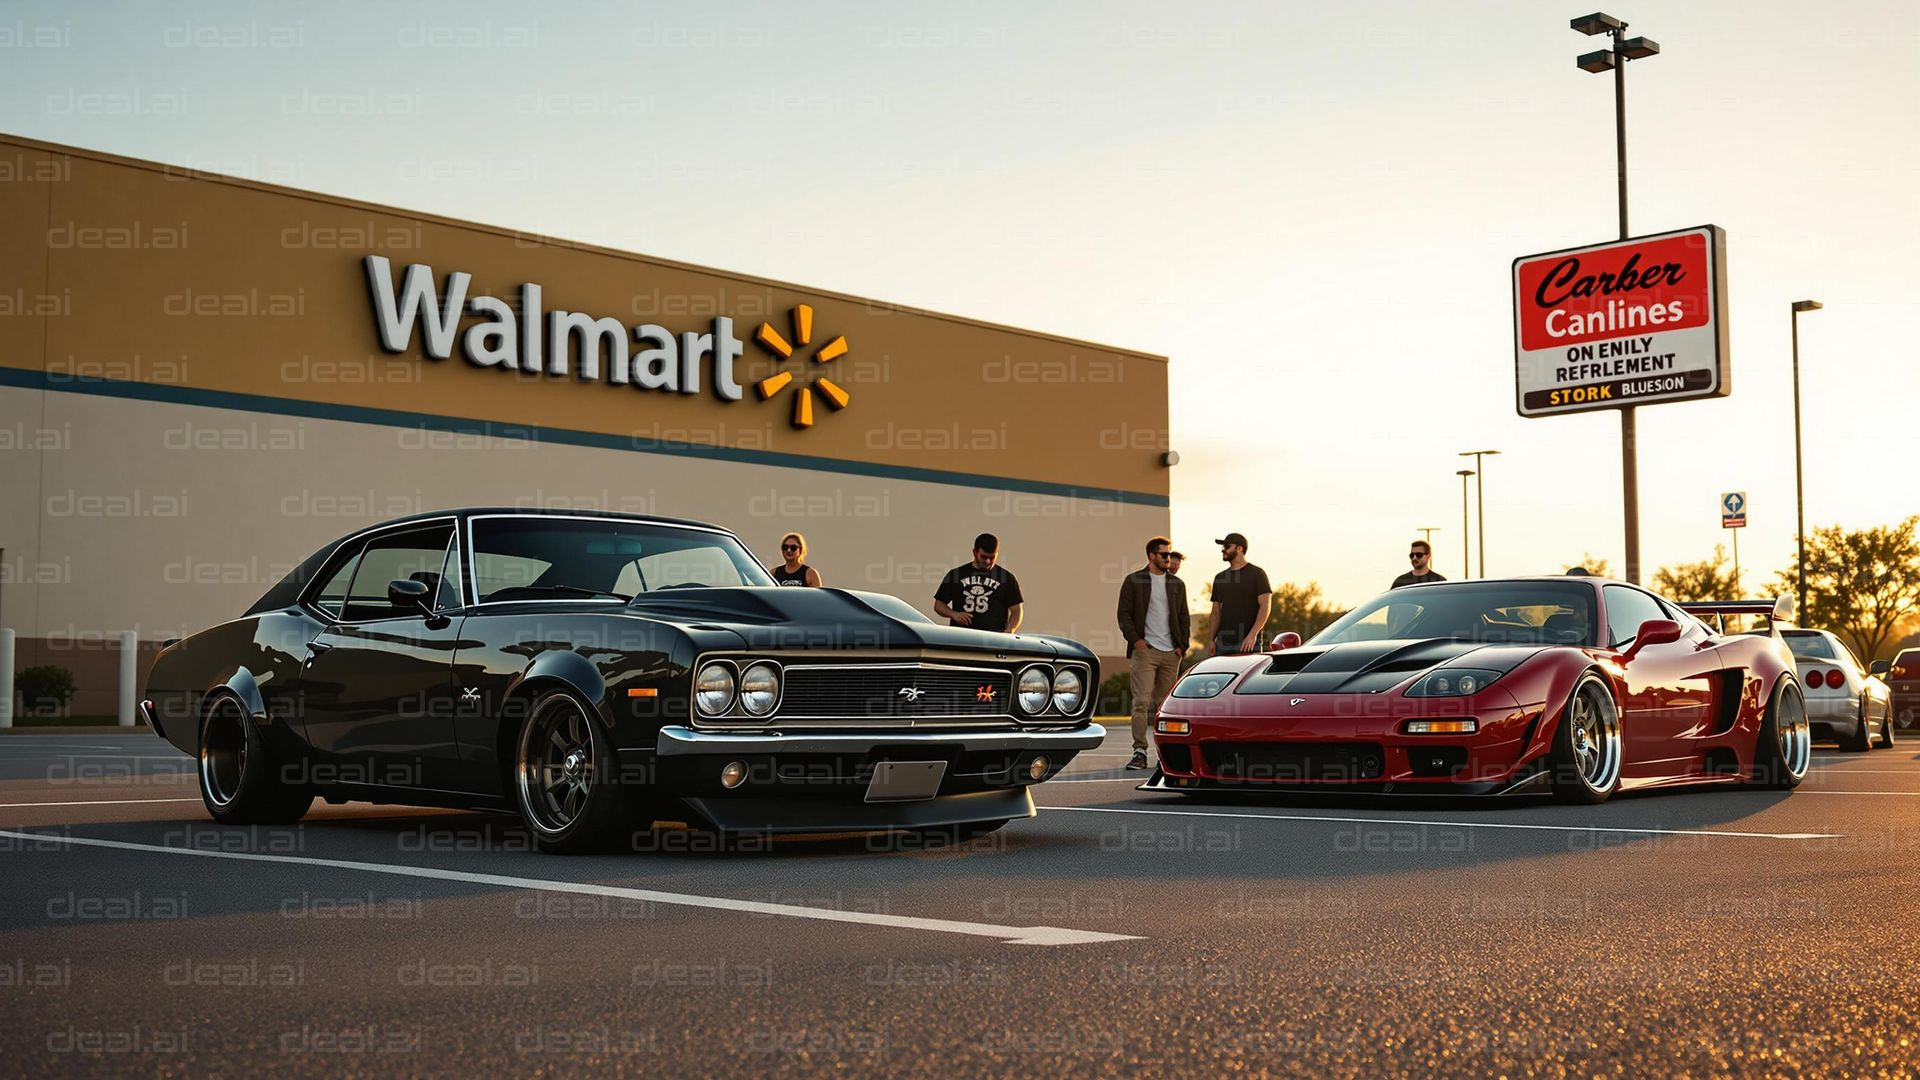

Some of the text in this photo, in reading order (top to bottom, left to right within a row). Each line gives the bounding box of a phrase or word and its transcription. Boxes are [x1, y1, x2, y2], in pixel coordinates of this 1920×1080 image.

[1535, 253, 1687, 309] Carber
[364, 254, 744, 402] Walmart
[1545, 300, 1684, 338] Canlines
[1567, 337, 1653, 363] ON ENILY
[1556, 354, 1676, 382] REFRLEMENT
[1550, 385, 1612, 405] STORK
